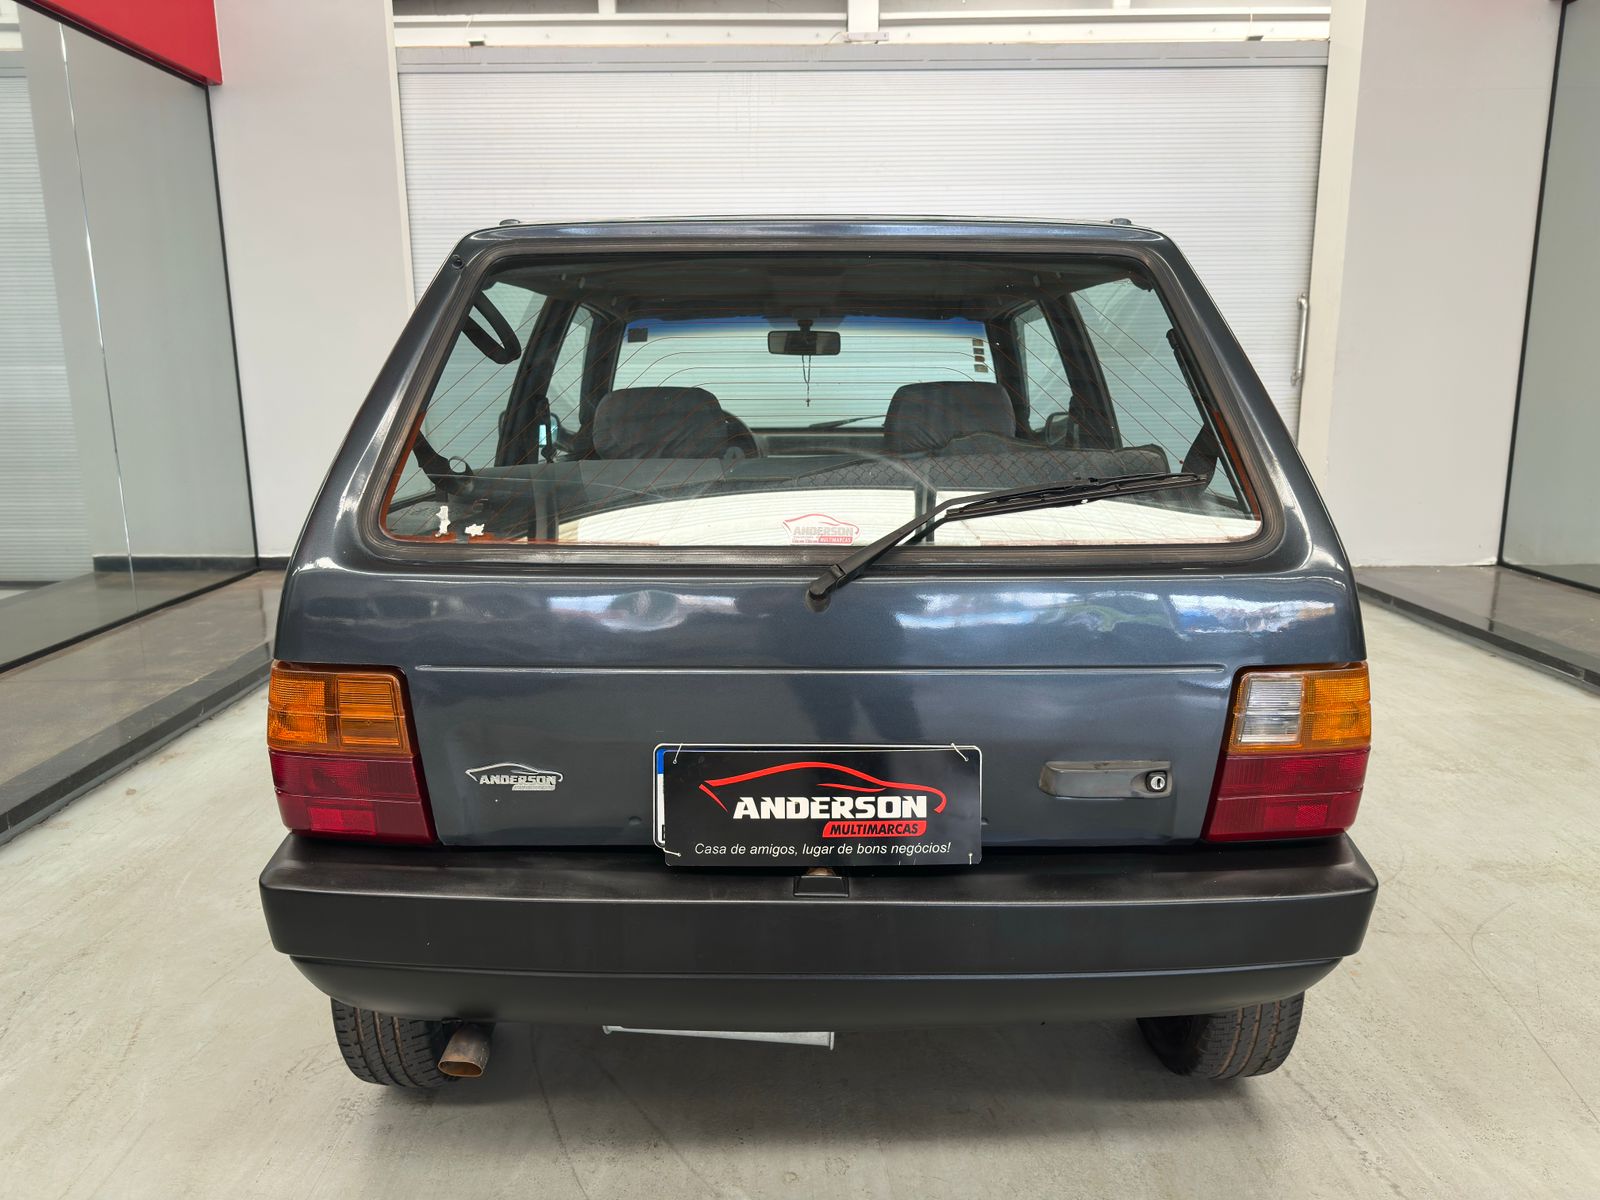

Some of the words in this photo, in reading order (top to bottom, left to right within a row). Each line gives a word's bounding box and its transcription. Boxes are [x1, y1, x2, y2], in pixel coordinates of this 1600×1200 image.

[793, 526, 854, 536] ANDERSON
[479, 775, 557, 785] ANDERSON
[733, 796, 927, 819] ANDERSON
[829, 823, 919, 835] MULTIMARCAS
[694, 842, 726, 855] Casa
[730, 843, 746, 855] de
[749, 843, 798, 859] amigos,
[802, 842, 835, 858] lugar
[838, 842, 853, 854] de
[856, 842, 888, 854] bons
[891, 842, 951, 858] negócios!
